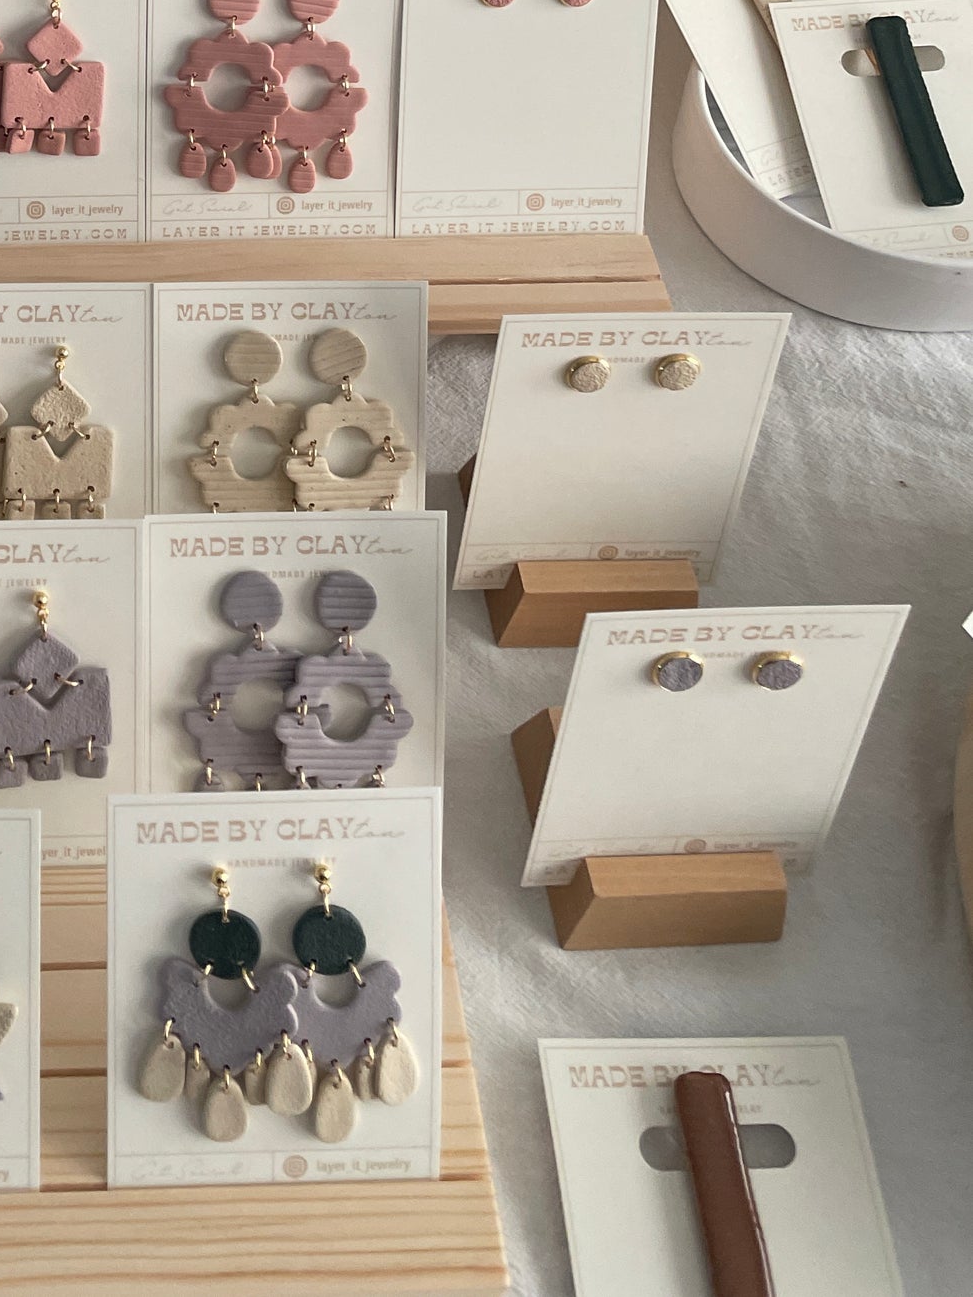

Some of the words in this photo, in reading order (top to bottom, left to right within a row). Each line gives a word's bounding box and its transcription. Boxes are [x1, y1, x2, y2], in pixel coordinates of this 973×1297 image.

[791, 15, 845, 31] MADE
[177, 303, 244, 322] MADE
[251, 302, 283, 320] BY
[522, 332, 593, 348] MADE
[601, 331, 635, 347] BY
[169, 536, 244, 557] MADE
[252, 535, 287, 556] BY
[607, 629, 686, 646] MADE
[696, 627, 734, 643] BY
[137, 821, 219, 845] MADE
[228, 819, 267, 842] BY
[568, 1065, 648, 1089] MADE
